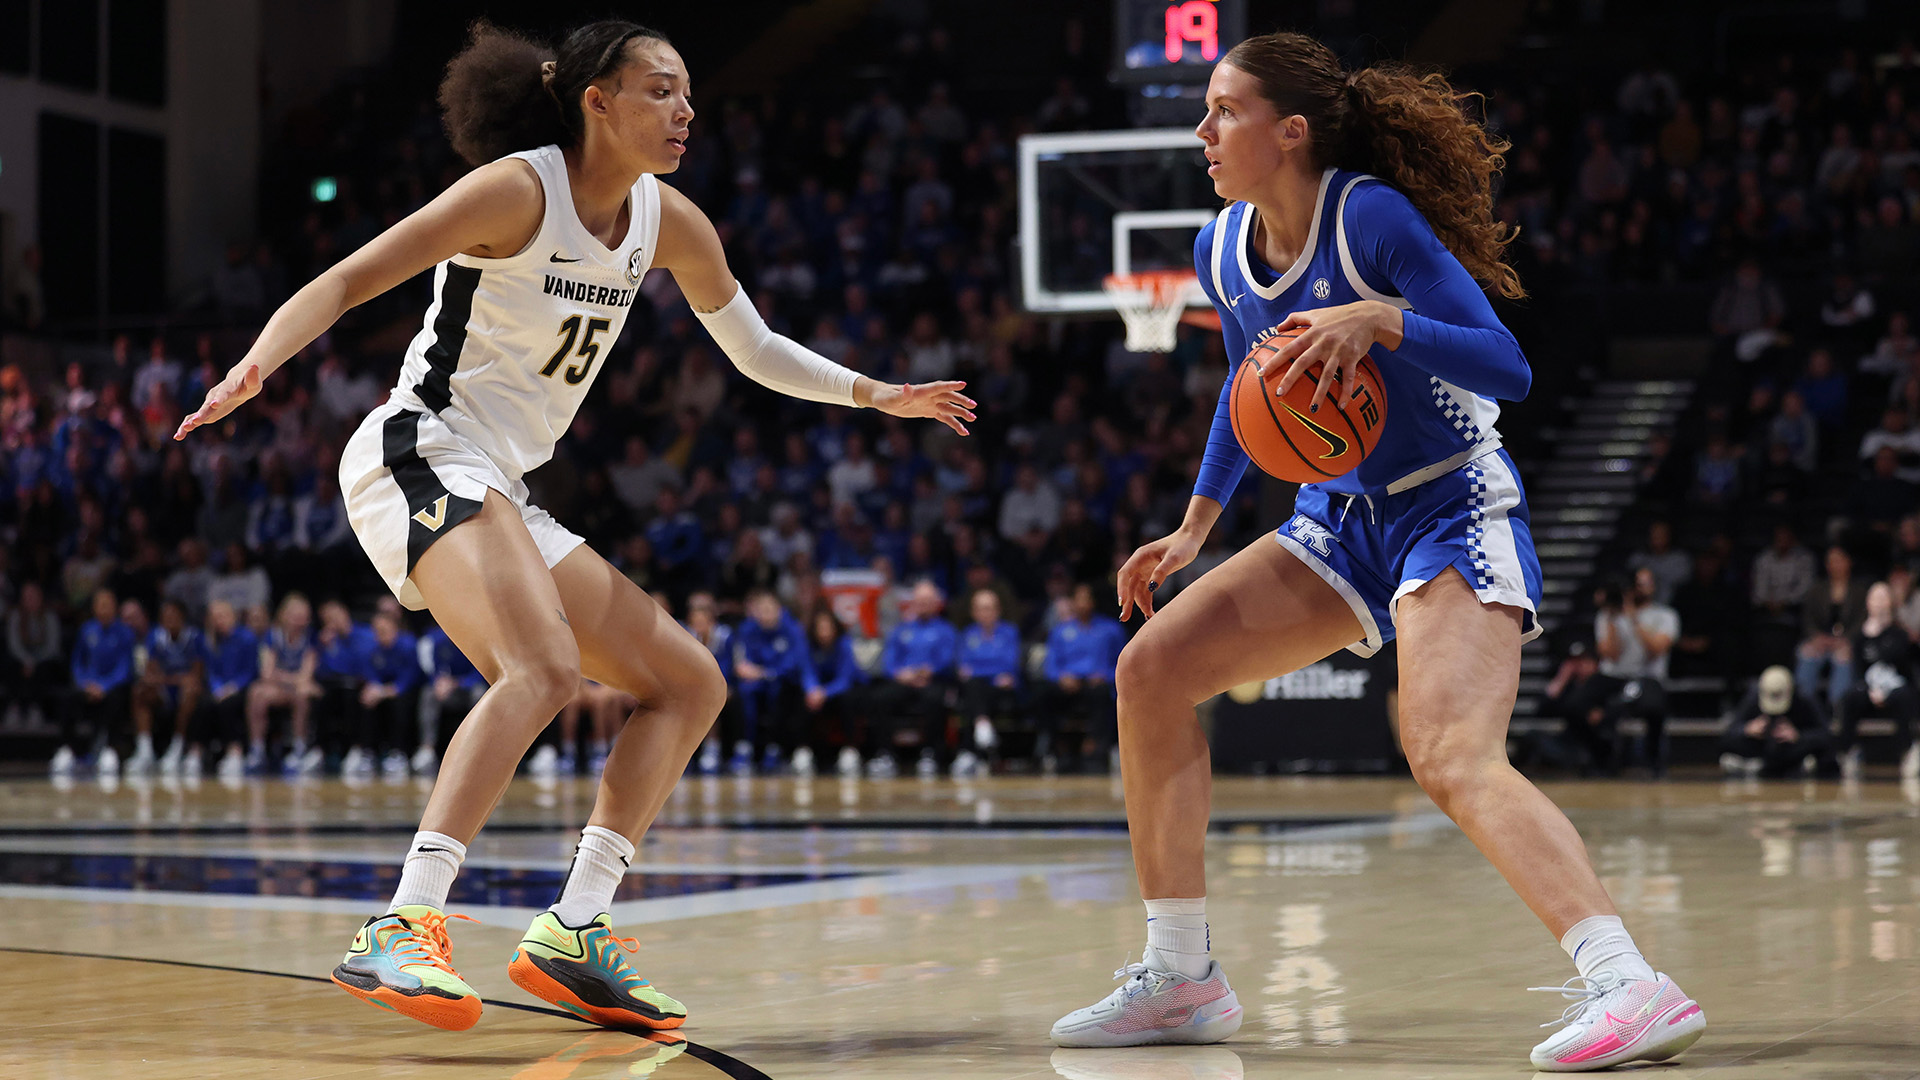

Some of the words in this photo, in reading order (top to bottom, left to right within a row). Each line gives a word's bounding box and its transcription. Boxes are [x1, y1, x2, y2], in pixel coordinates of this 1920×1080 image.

[1165, 0, 1219, 63] 19
[1314, 279, 1330, 299] SEC
[538, 313, 612, 386] 15
[411, 493, 450, 532] V
